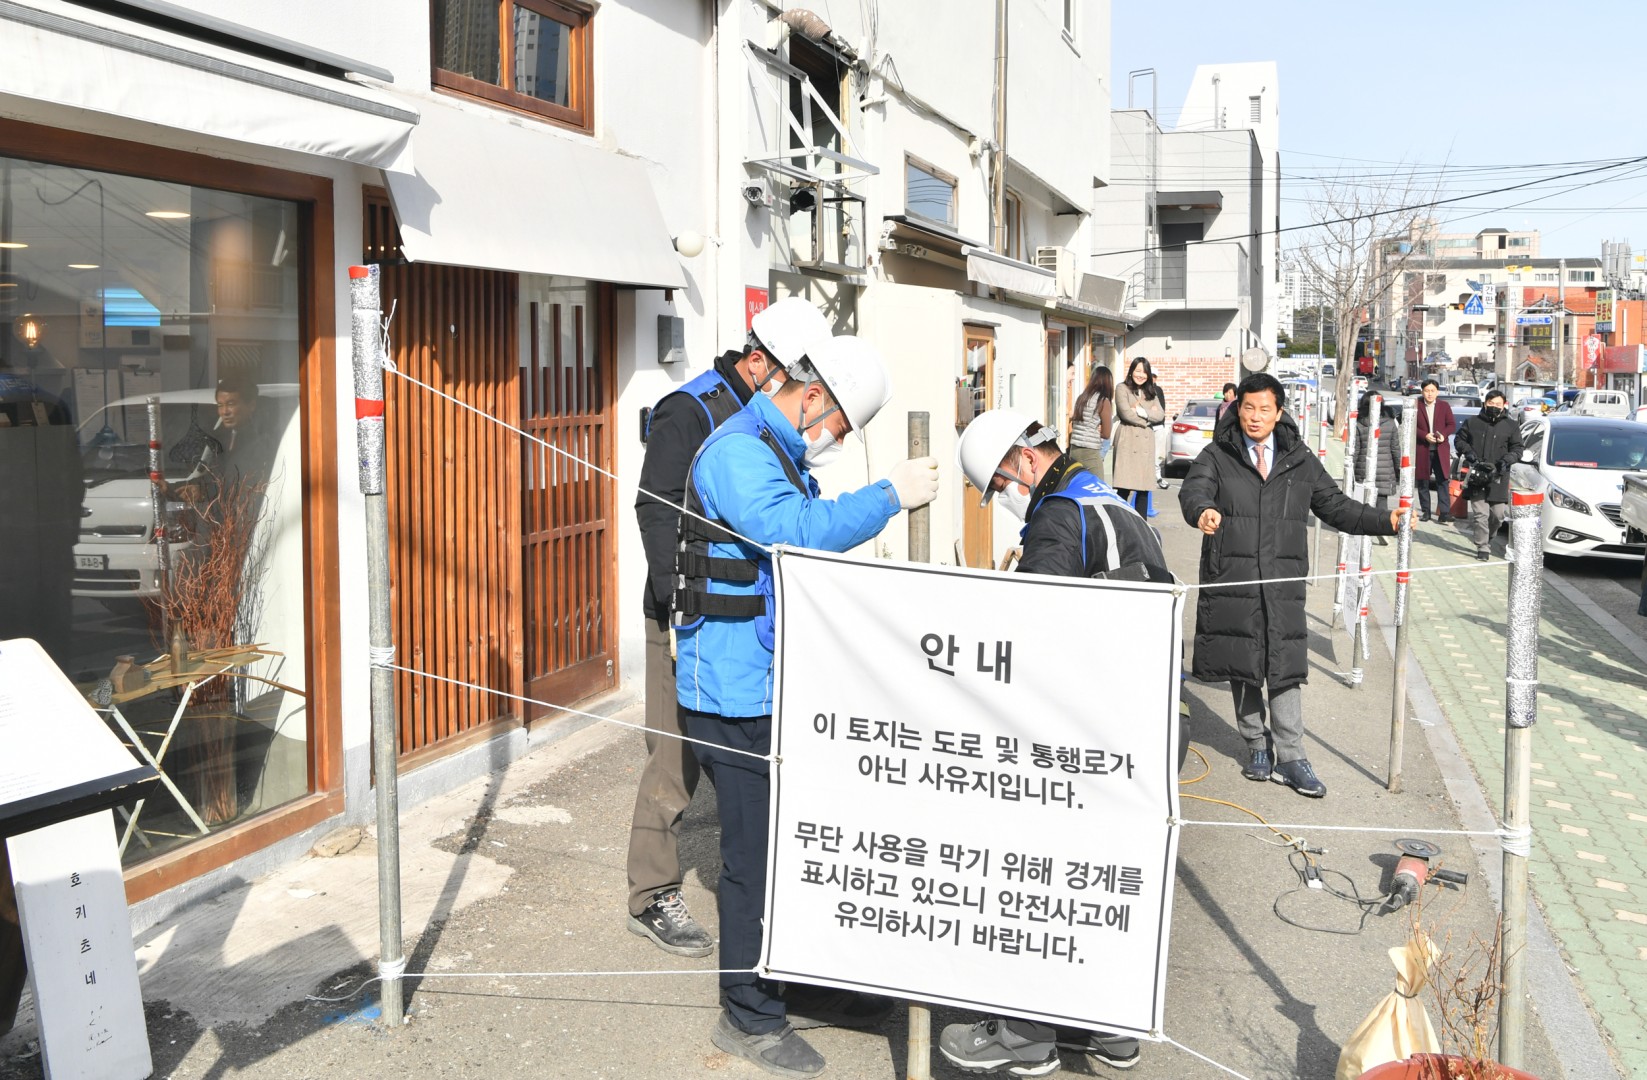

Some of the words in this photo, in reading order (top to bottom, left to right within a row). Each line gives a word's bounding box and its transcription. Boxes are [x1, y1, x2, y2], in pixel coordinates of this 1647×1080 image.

[1485, 285, 1494, 305] 간판
[1597, 303, 1612, 321] 부동산
[814, 713, 835, 739] 이
[847, 718, 922, 750] 토지는
[933, 731, 983, 758] 도로
[997, 736, 1017, 764] 및
[1031, 743, 1134, 779] 통행로가
[859, 755, 906, 785] 아닌
[919, 763, 1083, 809] 사유지입니다.
[795, 822, 843, 853] 무단
[853, 832, 928, 866] 사용을
[940, 844, 989, 876] 막기
[1002, 853, 1052, 885] 위해
[1066, 862, 1143, 895] 경계를
[801, 860, 898, 897] 표시하고
[912, 877, 985, 914] 있으니
[999, 891, 1129, 932] 안전사고에
[70, 872, 97, 985] 호키츠네
[835, 902, 960, 945] 유의하시기
[973, 925, 1083, 963] 바랍니다.
